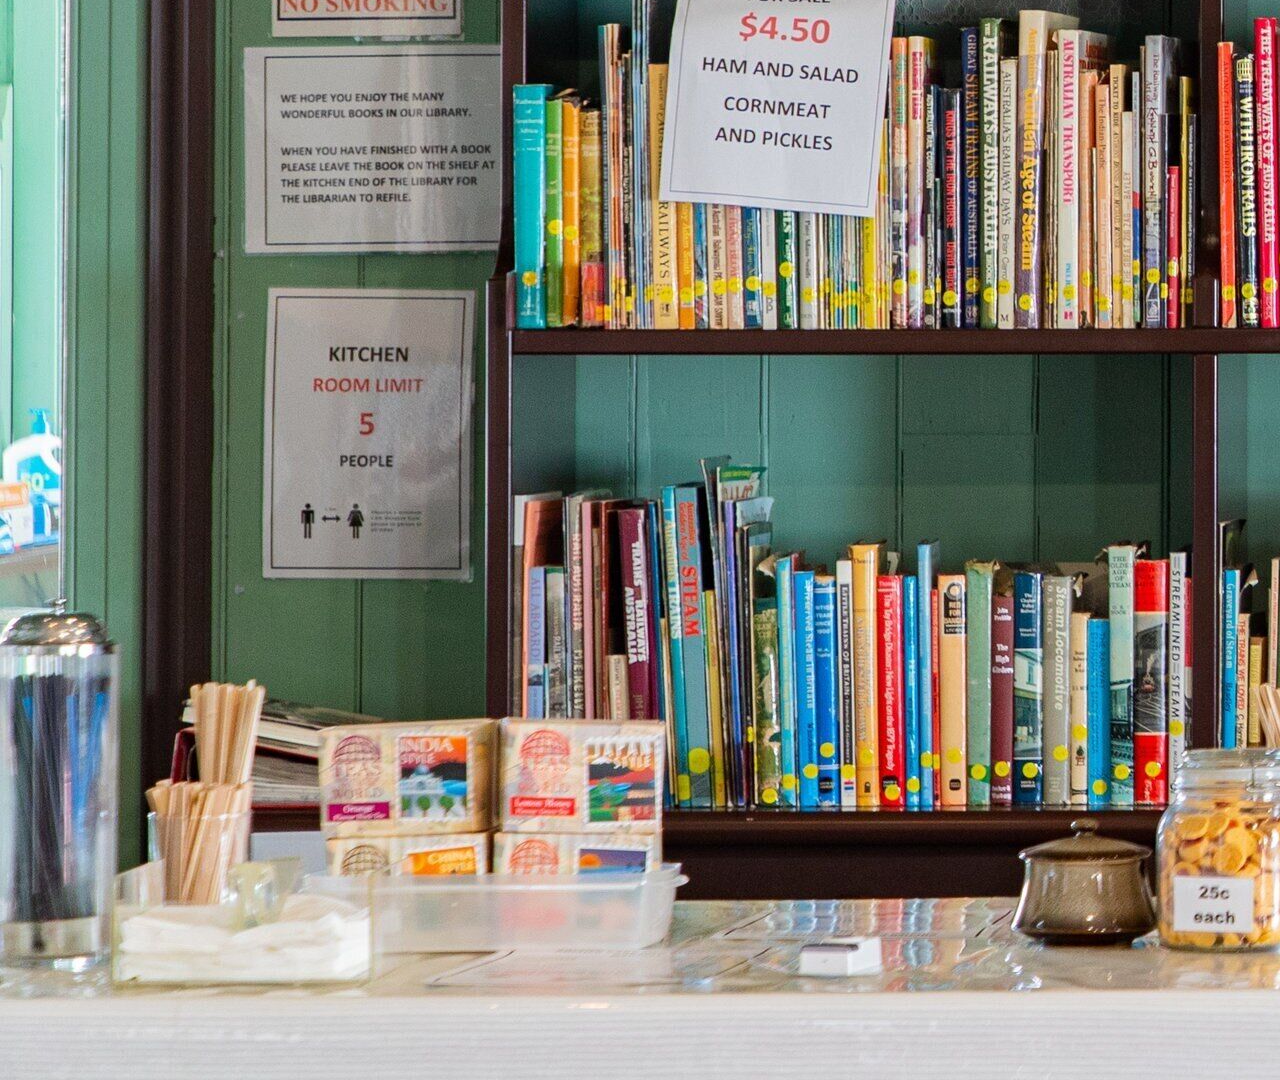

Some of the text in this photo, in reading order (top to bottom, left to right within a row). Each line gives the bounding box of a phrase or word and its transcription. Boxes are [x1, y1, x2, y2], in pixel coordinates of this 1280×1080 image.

[739, 12, 830, 44] $4.50
[703, 57, 858, 83] HAM AND SALAD
[300, 94, 327, 102] HOPE
[331, 94, 351, 102] YOU
[356, 93, 386, 102] ENJOY
[390, 93, 408, 101] THE
[412, 93, 444, 101] MANY
[724, 97, 830, 119] CORNMEAT
[281, 109, 472, 118] WONDERFUL BOOKS IN OUR LIBRARY.
[1063, 39, 1074, 203] AUSTRALIAN TRANSPORT
[715, 127, 832, 150] AND PICKLES
[984, 36, 996, 250] RAILWAYS AUSTRALIA
[1261, 27, 1275, 242] THE TRAMWAYS OF AUSTRALIA
[281, 145, 491, 155] WHEN YOU HAVE FINISHED WITH A BOOK
[966, 34, 978, 258] GREAT STEAM TRAINS OF AUSTRALIA
[281, 161, 495, 171] PLEASE LEAVE THE BOOK ON THE SHELF AT
[1240, 96, 1255, 236] WITH IRON RAILS
[281, 177, 477, 187] THE KITCHEN END OF THE LIBRARY FOR
[281, 194, 411, 203] THE LIBRARIAN TO REFILE.
[658, 202, 669, 279] RAILWAYS
[329, 347, 408, 362] KITCHEN
[313, 378, 423, 393] ROOM LIMIT
[359, 412, 375, 436] 5
[340, 455, 394, 467] PEOPLE
[681, 566, 698, 636] STEAM
[1171, 570, 1181, 718] STREAMLINED STEAM
[1198, 884, 1231, 901] 25c
[1193, 910, 1236, 925] each
